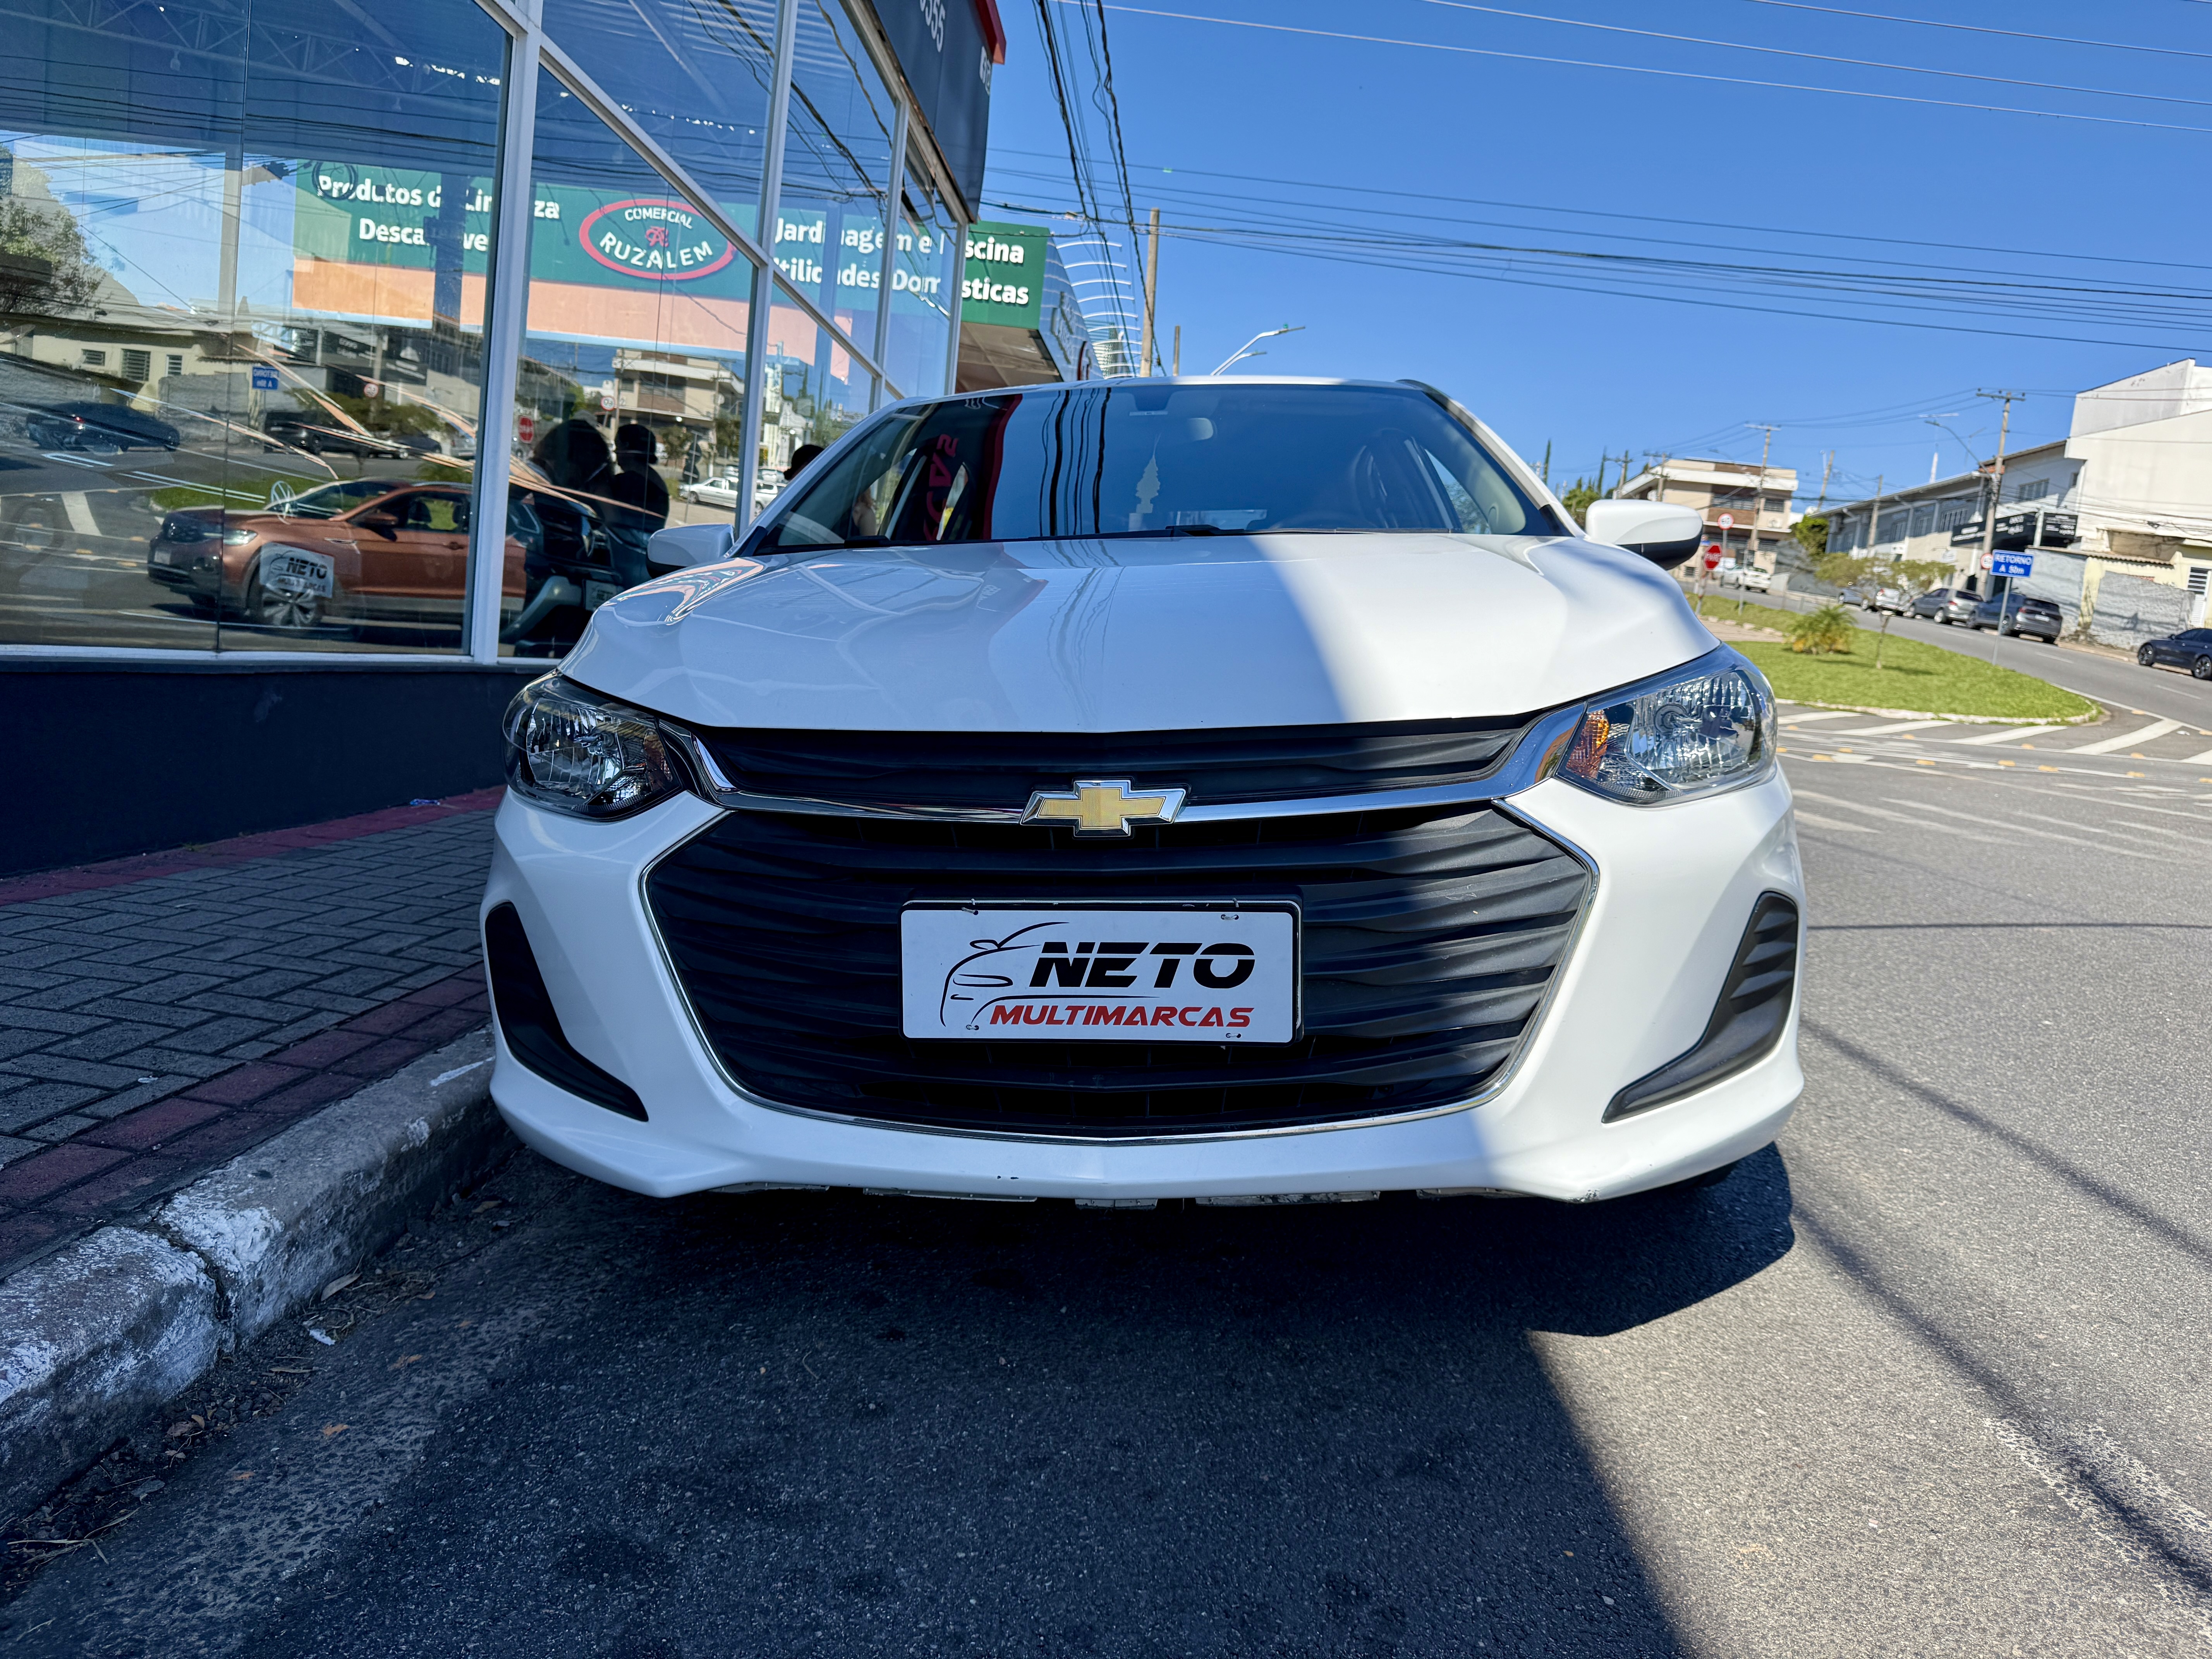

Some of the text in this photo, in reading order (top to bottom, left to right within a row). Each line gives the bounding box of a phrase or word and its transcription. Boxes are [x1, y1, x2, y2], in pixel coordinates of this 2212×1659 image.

[624, 207, 693, 229] COMERCIAL
[599, 231, 713, 270] RUZALEM
[939, 232, 1024, 264] scina
[892, 268, 1029, 305] Domsticas
[287, 557, 328, 579] NETO
[1995, 553, 2032, 565] RETORNO
[1999, 564, 2006, 573] A
[1029, 941, 1255, 989] NETO
[989, 1005, 1255, 1027] MULTIMARCAS
